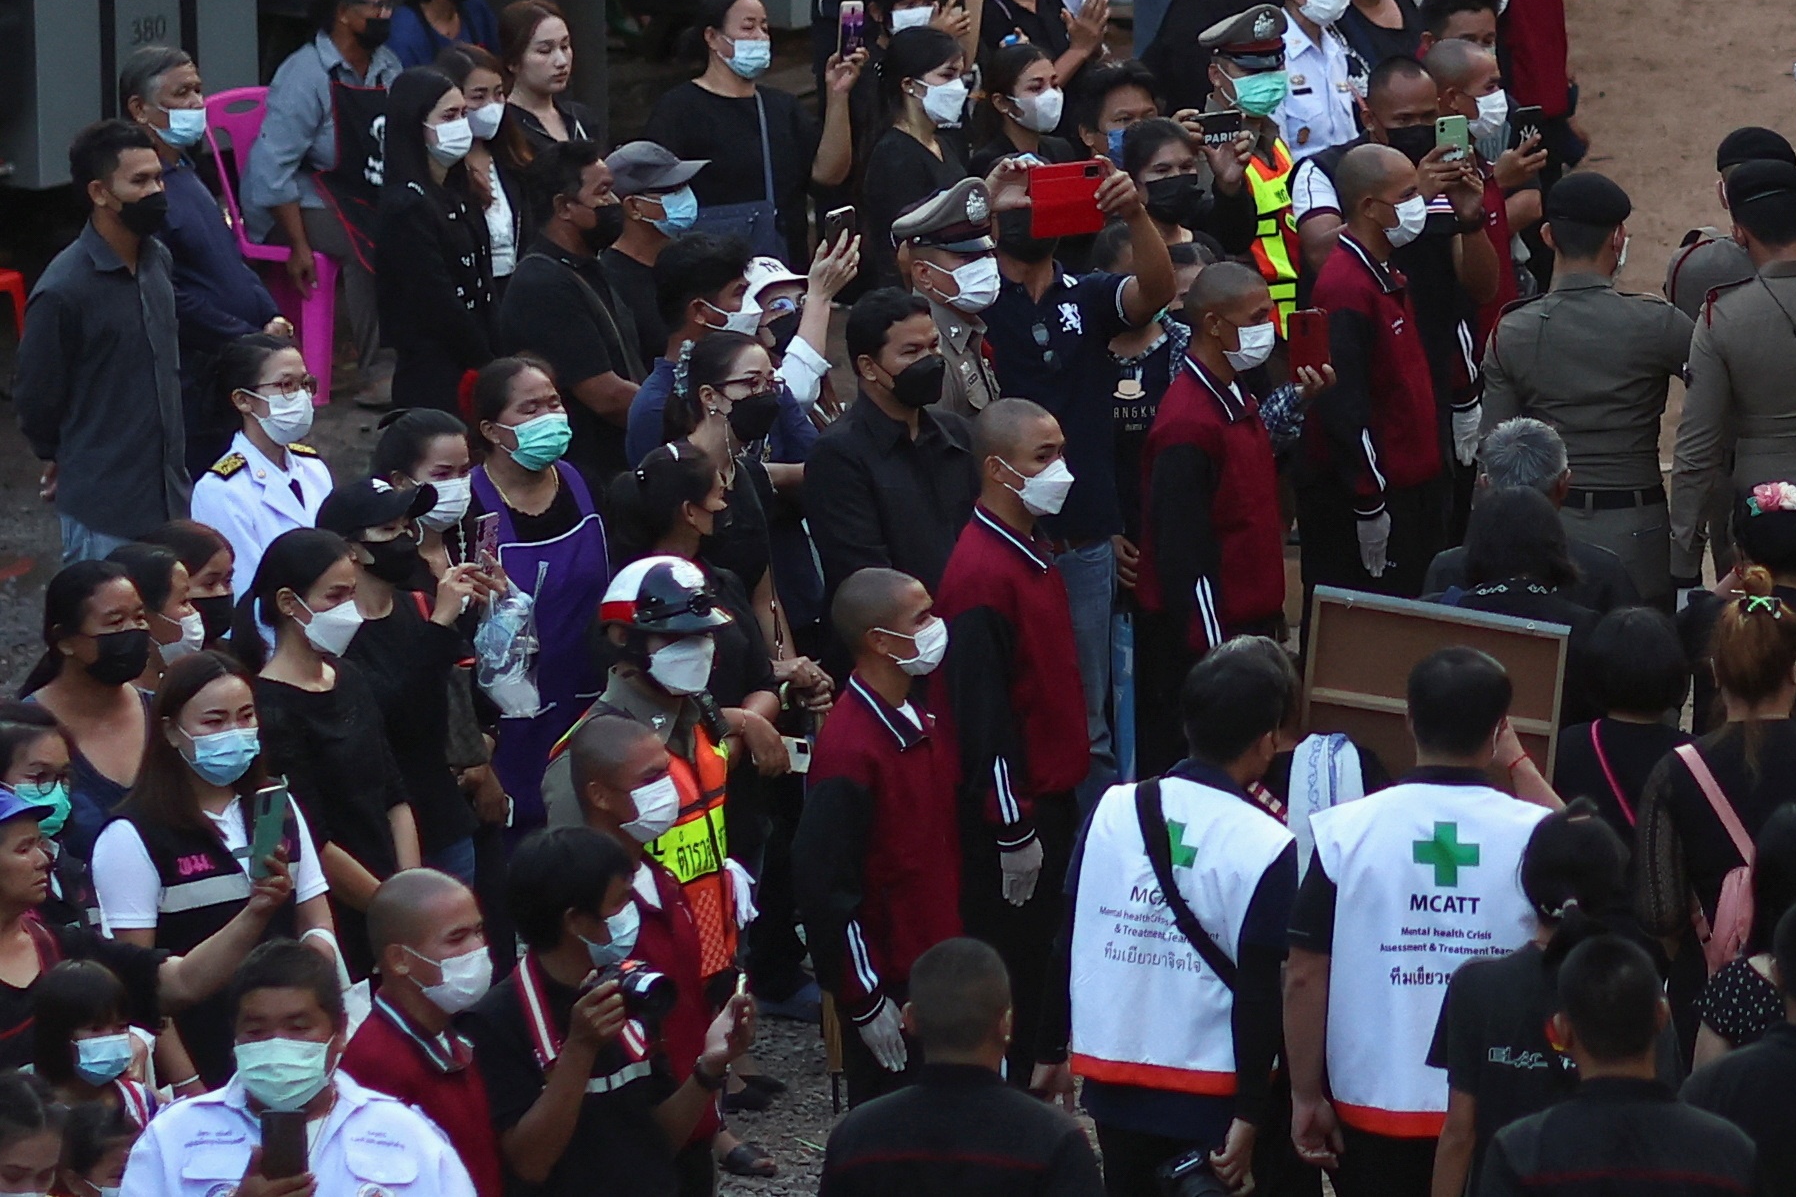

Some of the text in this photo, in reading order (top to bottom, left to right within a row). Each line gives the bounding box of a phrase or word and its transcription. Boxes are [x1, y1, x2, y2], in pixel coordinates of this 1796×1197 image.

[131, 14, 167, 45] 380
[1409, 893, 1481, 915] MCATT
[1114, 923, 1121, 934] &
[1123, 925, 1166, 941] Treatment
[1401, 926, 1492, 941] Mental health Crisis
[1104, 941, 1201, 973] ทีมเยียวยาจิตใจ
[1380, 943, 1427, 953] Assessment
[1428, 943, 1437, 952] &
[1438, 944, 1490, 956] Treatment
